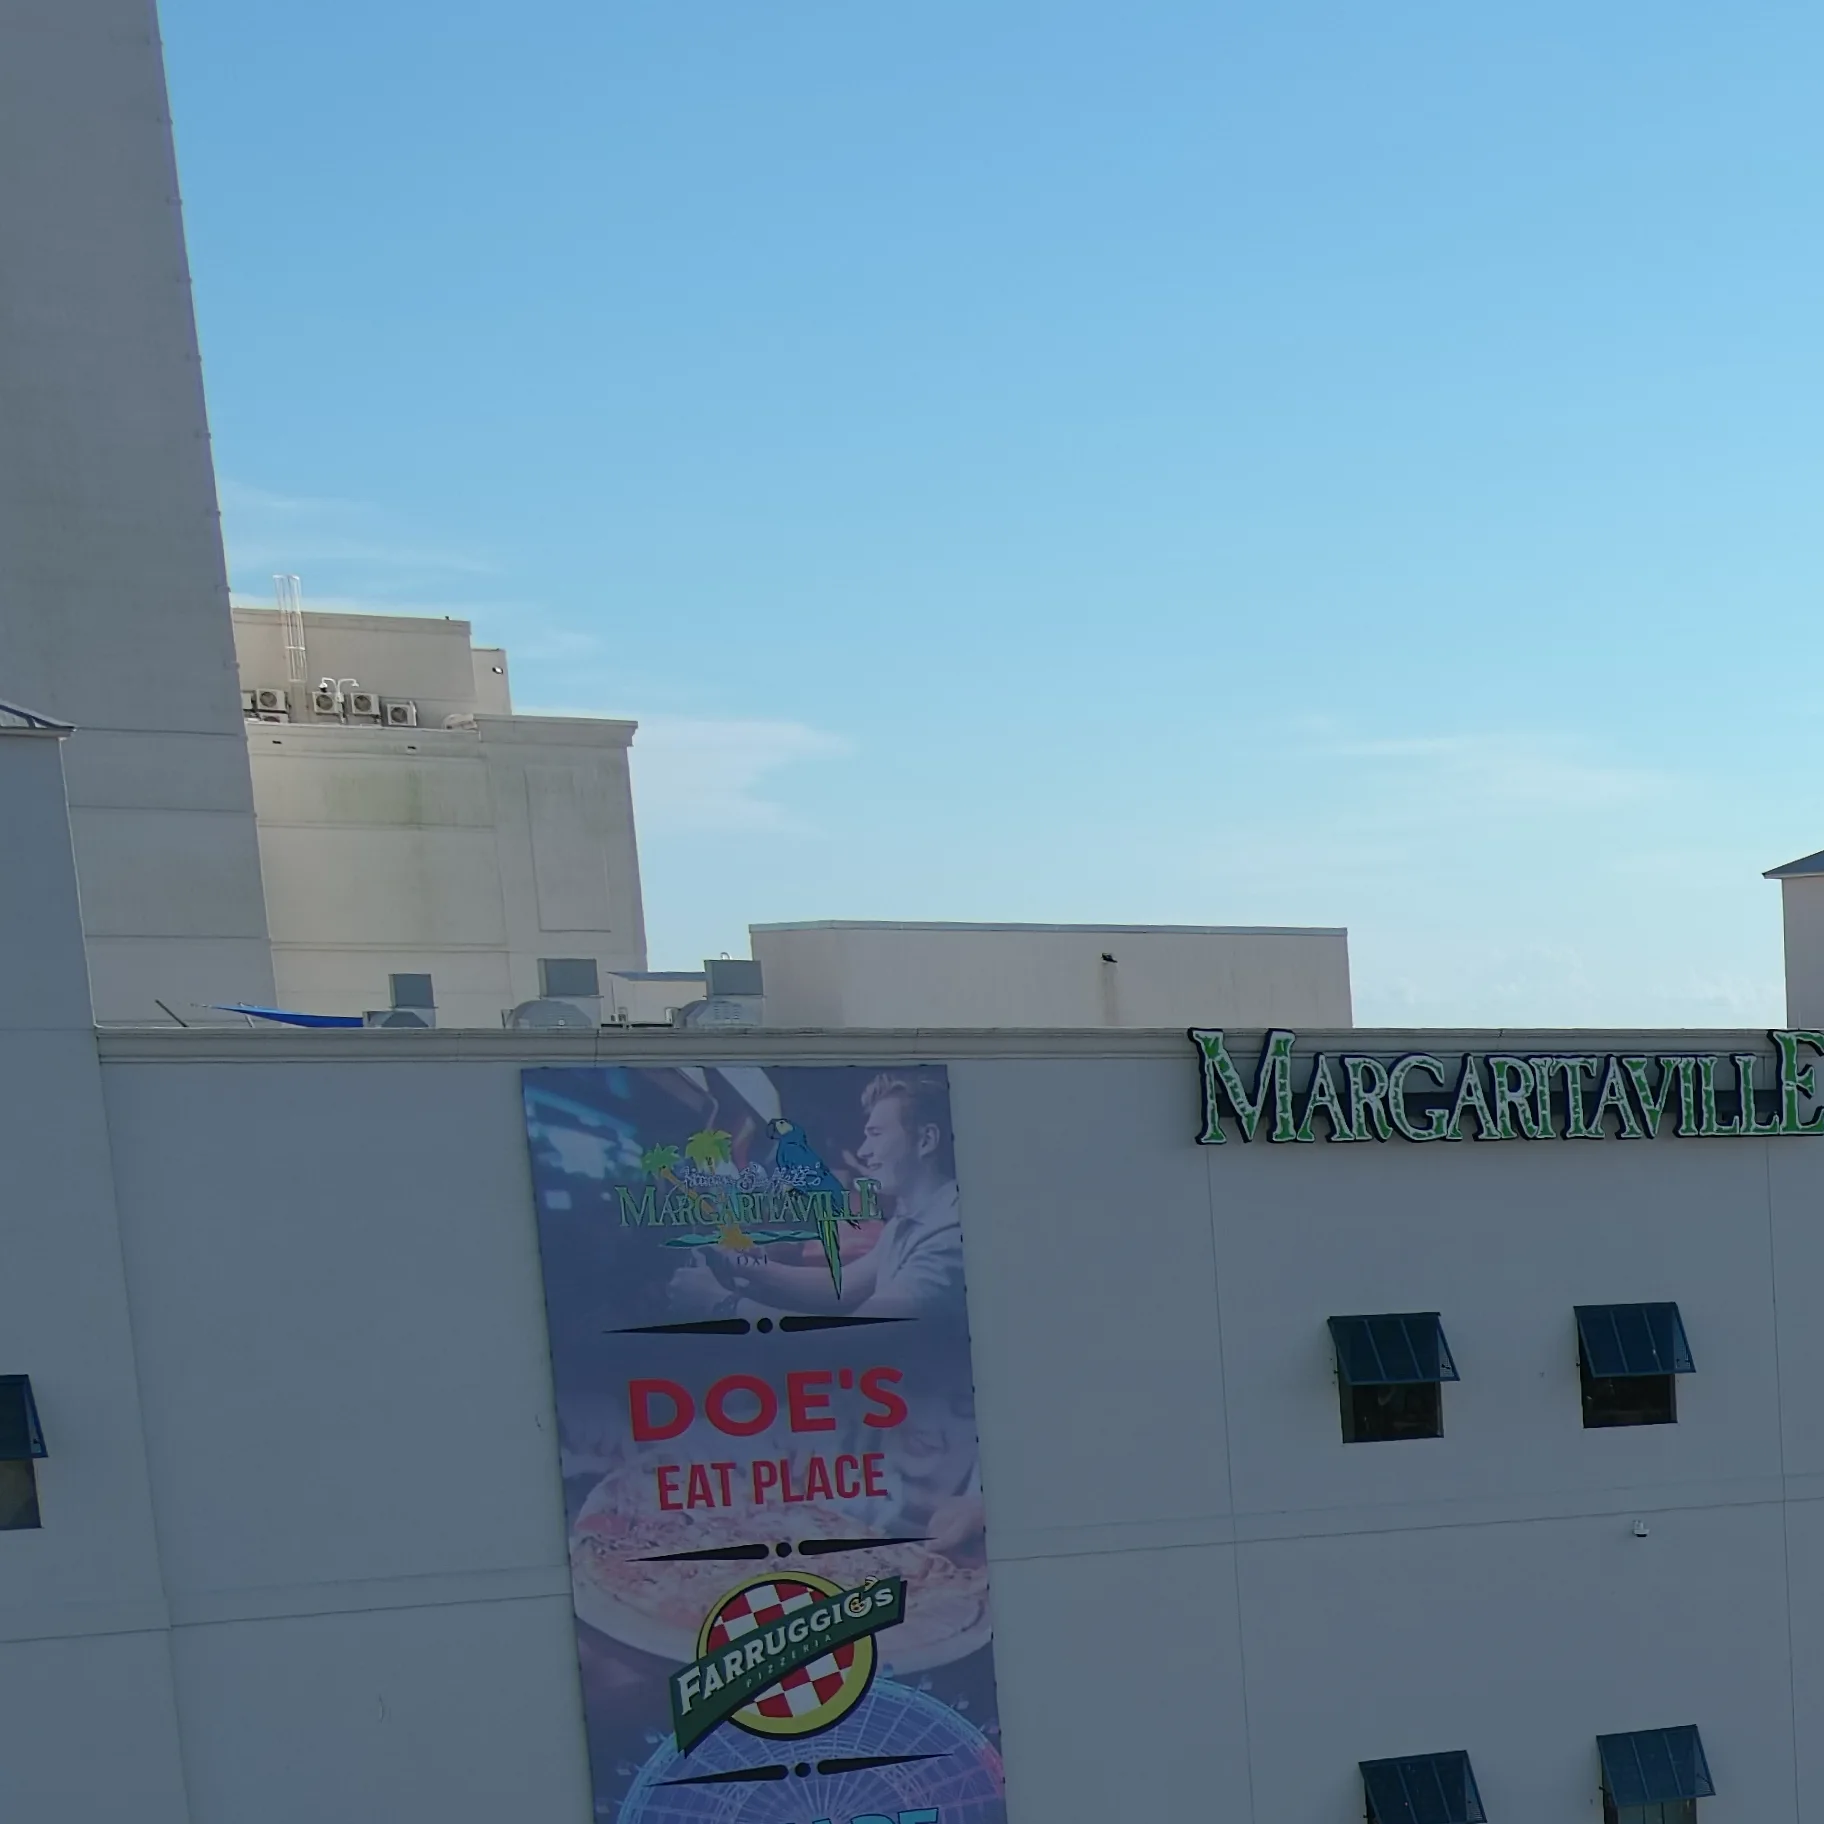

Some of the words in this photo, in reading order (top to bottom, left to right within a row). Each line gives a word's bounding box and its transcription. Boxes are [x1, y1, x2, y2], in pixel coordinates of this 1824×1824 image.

[614, 1178, 883, 1228] MARGARITAVILLE
[628, 1365, 909, 1442] DOE'S
[657, 1461, 738, 1512] EAT
[752, 1453, 889, 1505] PLACE
